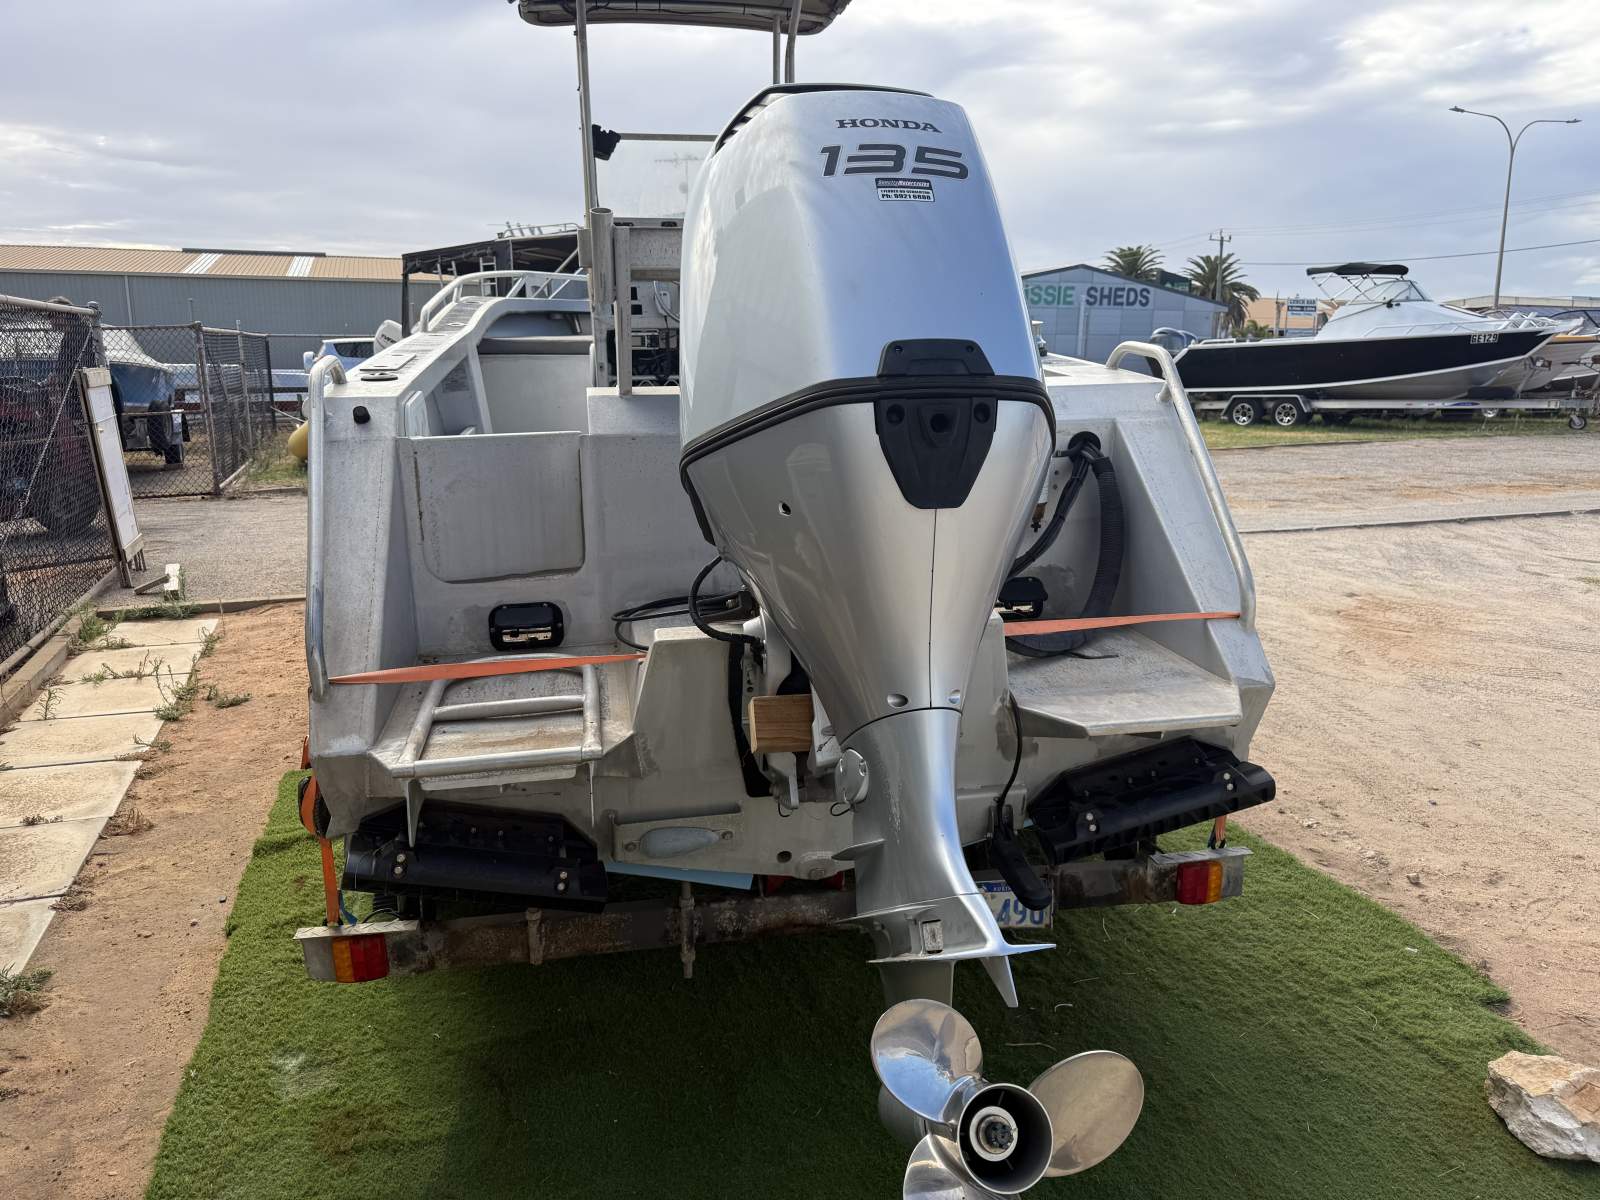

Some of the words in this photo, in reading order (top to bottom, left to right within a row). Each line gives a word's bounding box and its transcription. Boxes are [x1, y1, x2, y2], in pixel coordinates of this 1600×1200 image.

[836, 118, 942, 133] HONDA
[820, 143, 969, 180] 135
[1025, 286, 1075, 305] SSIE
[1085, 286, 1150, 307] SHEDS
